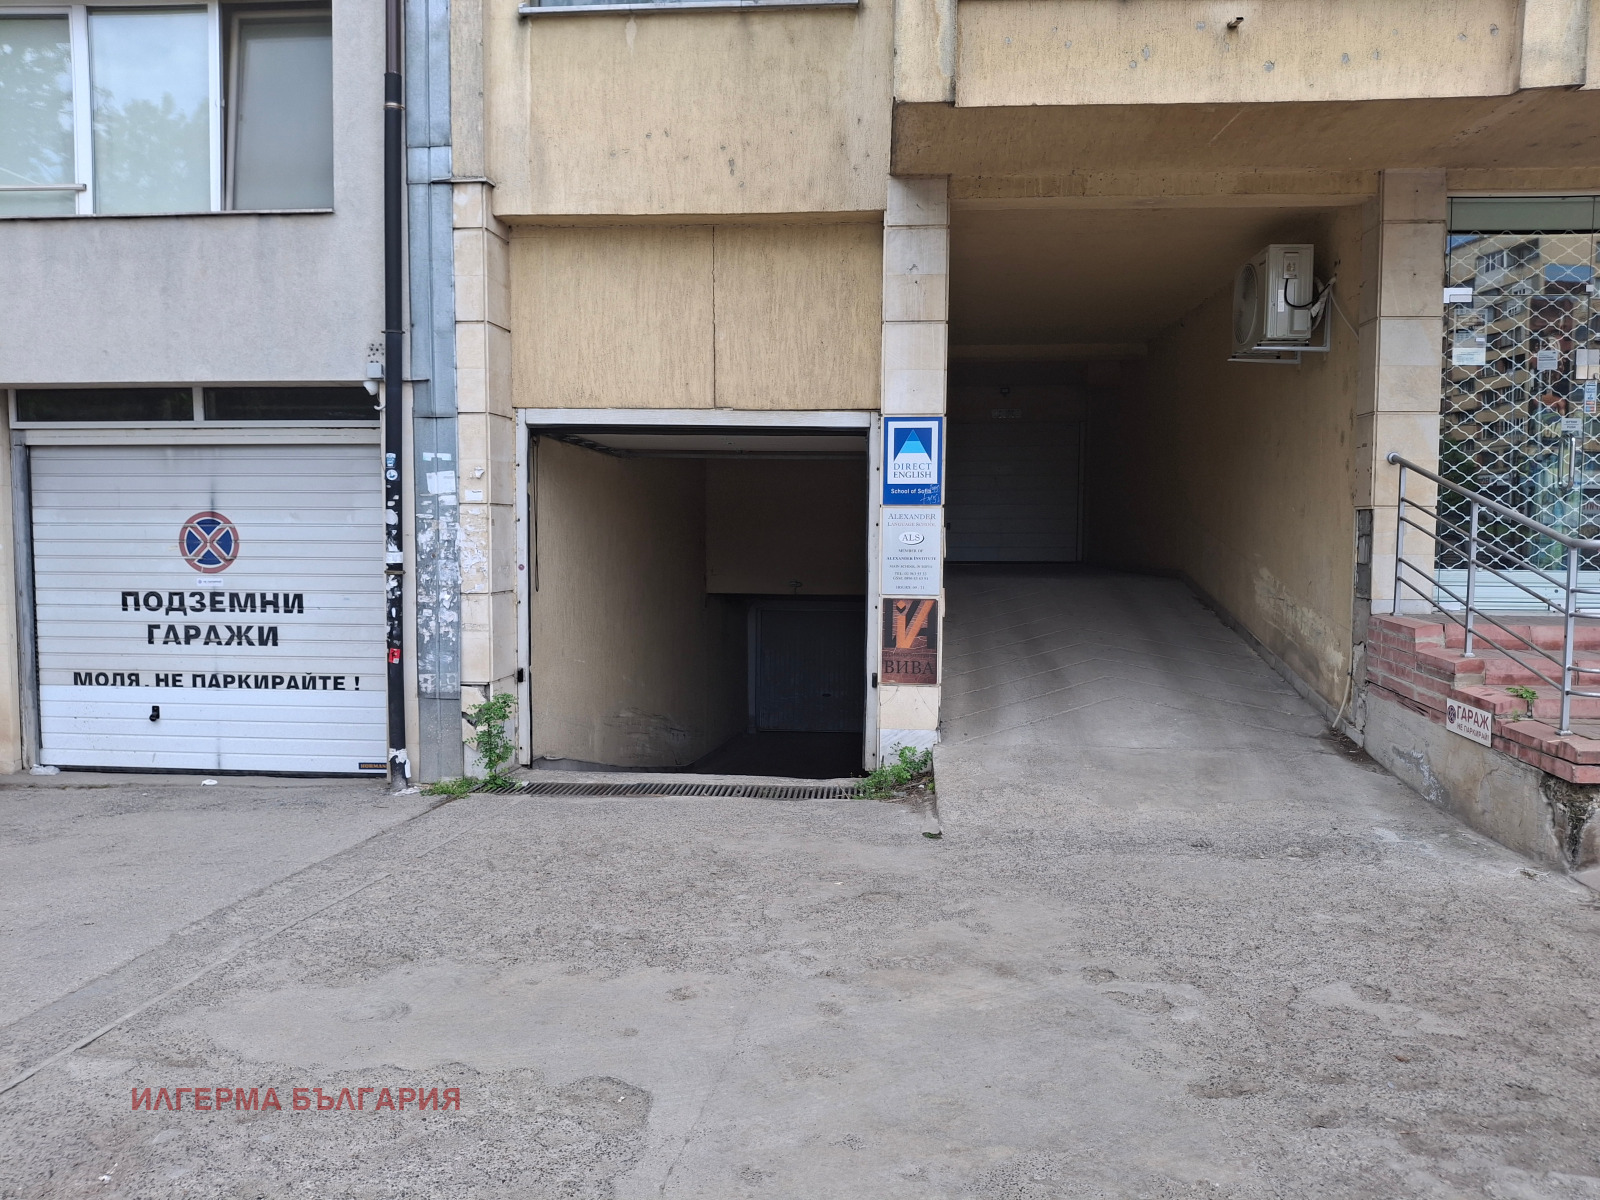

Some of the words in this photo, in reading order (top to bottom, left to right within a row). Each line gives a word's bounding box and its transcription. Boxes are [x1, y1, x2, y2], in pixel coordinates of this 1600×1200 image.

[893, 471, 932, 479] ENGLISH
[902, 534, 920, 542] ALS
[121, 591, 304, 616] ПОДЗЕМНИ
[147, 624, 279, 647] ГАРАЖИ
[884, 660, 934, 674] ВИВА
[155, 673, 184, 688] НЕ
[192, 672, 346, 691] ПАРКИРАЙТЕ
[1456, 705, 1490, 731] ГАРАЖ
[1456, 722, 1463, 731] НЕ
